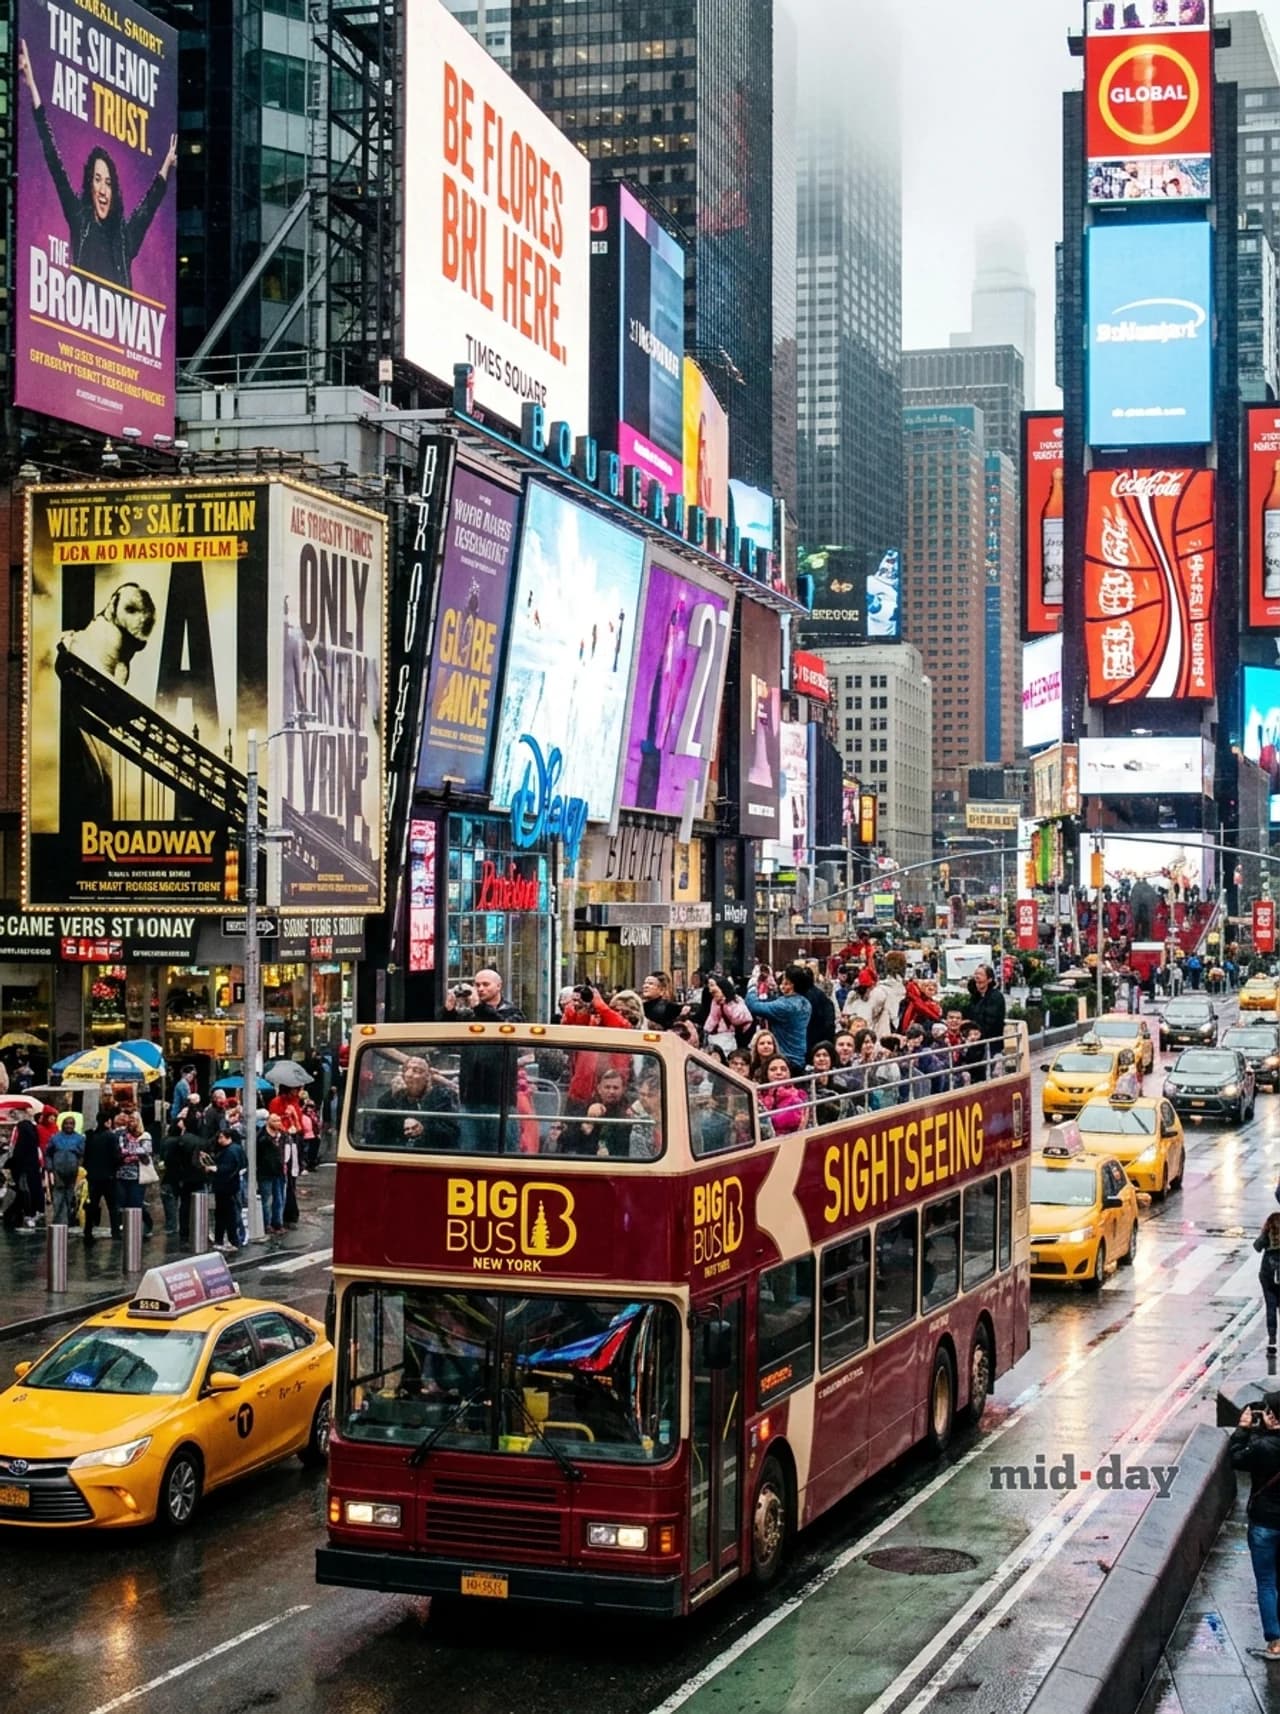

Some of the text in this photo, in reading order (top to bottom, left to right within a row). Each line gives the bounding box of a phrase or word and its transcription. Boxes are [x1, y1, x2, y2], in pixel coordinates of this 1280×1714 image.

[47, 2, 83, 66] THE
[52, 61, 153, 156] ARE TRUST.
[1110, 84, 1188, 103] GLOBAL
[444, 60, 563, 260] BE FLORES
[48, 234, 69, 268] THE
[443, 172, 493, 312] BRL
[503, 223, 567, 366] HERE.
[30, 245, 167, 358] BROADWAY
[466, 334, 502, 382] TIMES
[123, 541, 188, 560] MASION
[193, 540, 232, 558] FILM
[300, 543, 370, 652] ONLY
[81, 821, 216, 862] BROADWAY
[7, 916, 55, 937] CAME
[60, 916, 106, 938] VERS
[824, 1101, 984, 1224] SIGHTSEEING
[447, 1178, 518, 1219] BIG
[694, 1180, 722, 1227] BIG
[447, 1219, 516, 1254] BUS
[694, 1222, 722, 1265] BUS
[473, 1257, 542, 1272] NEW YORK
[240, 1408, 250, 1433] T
